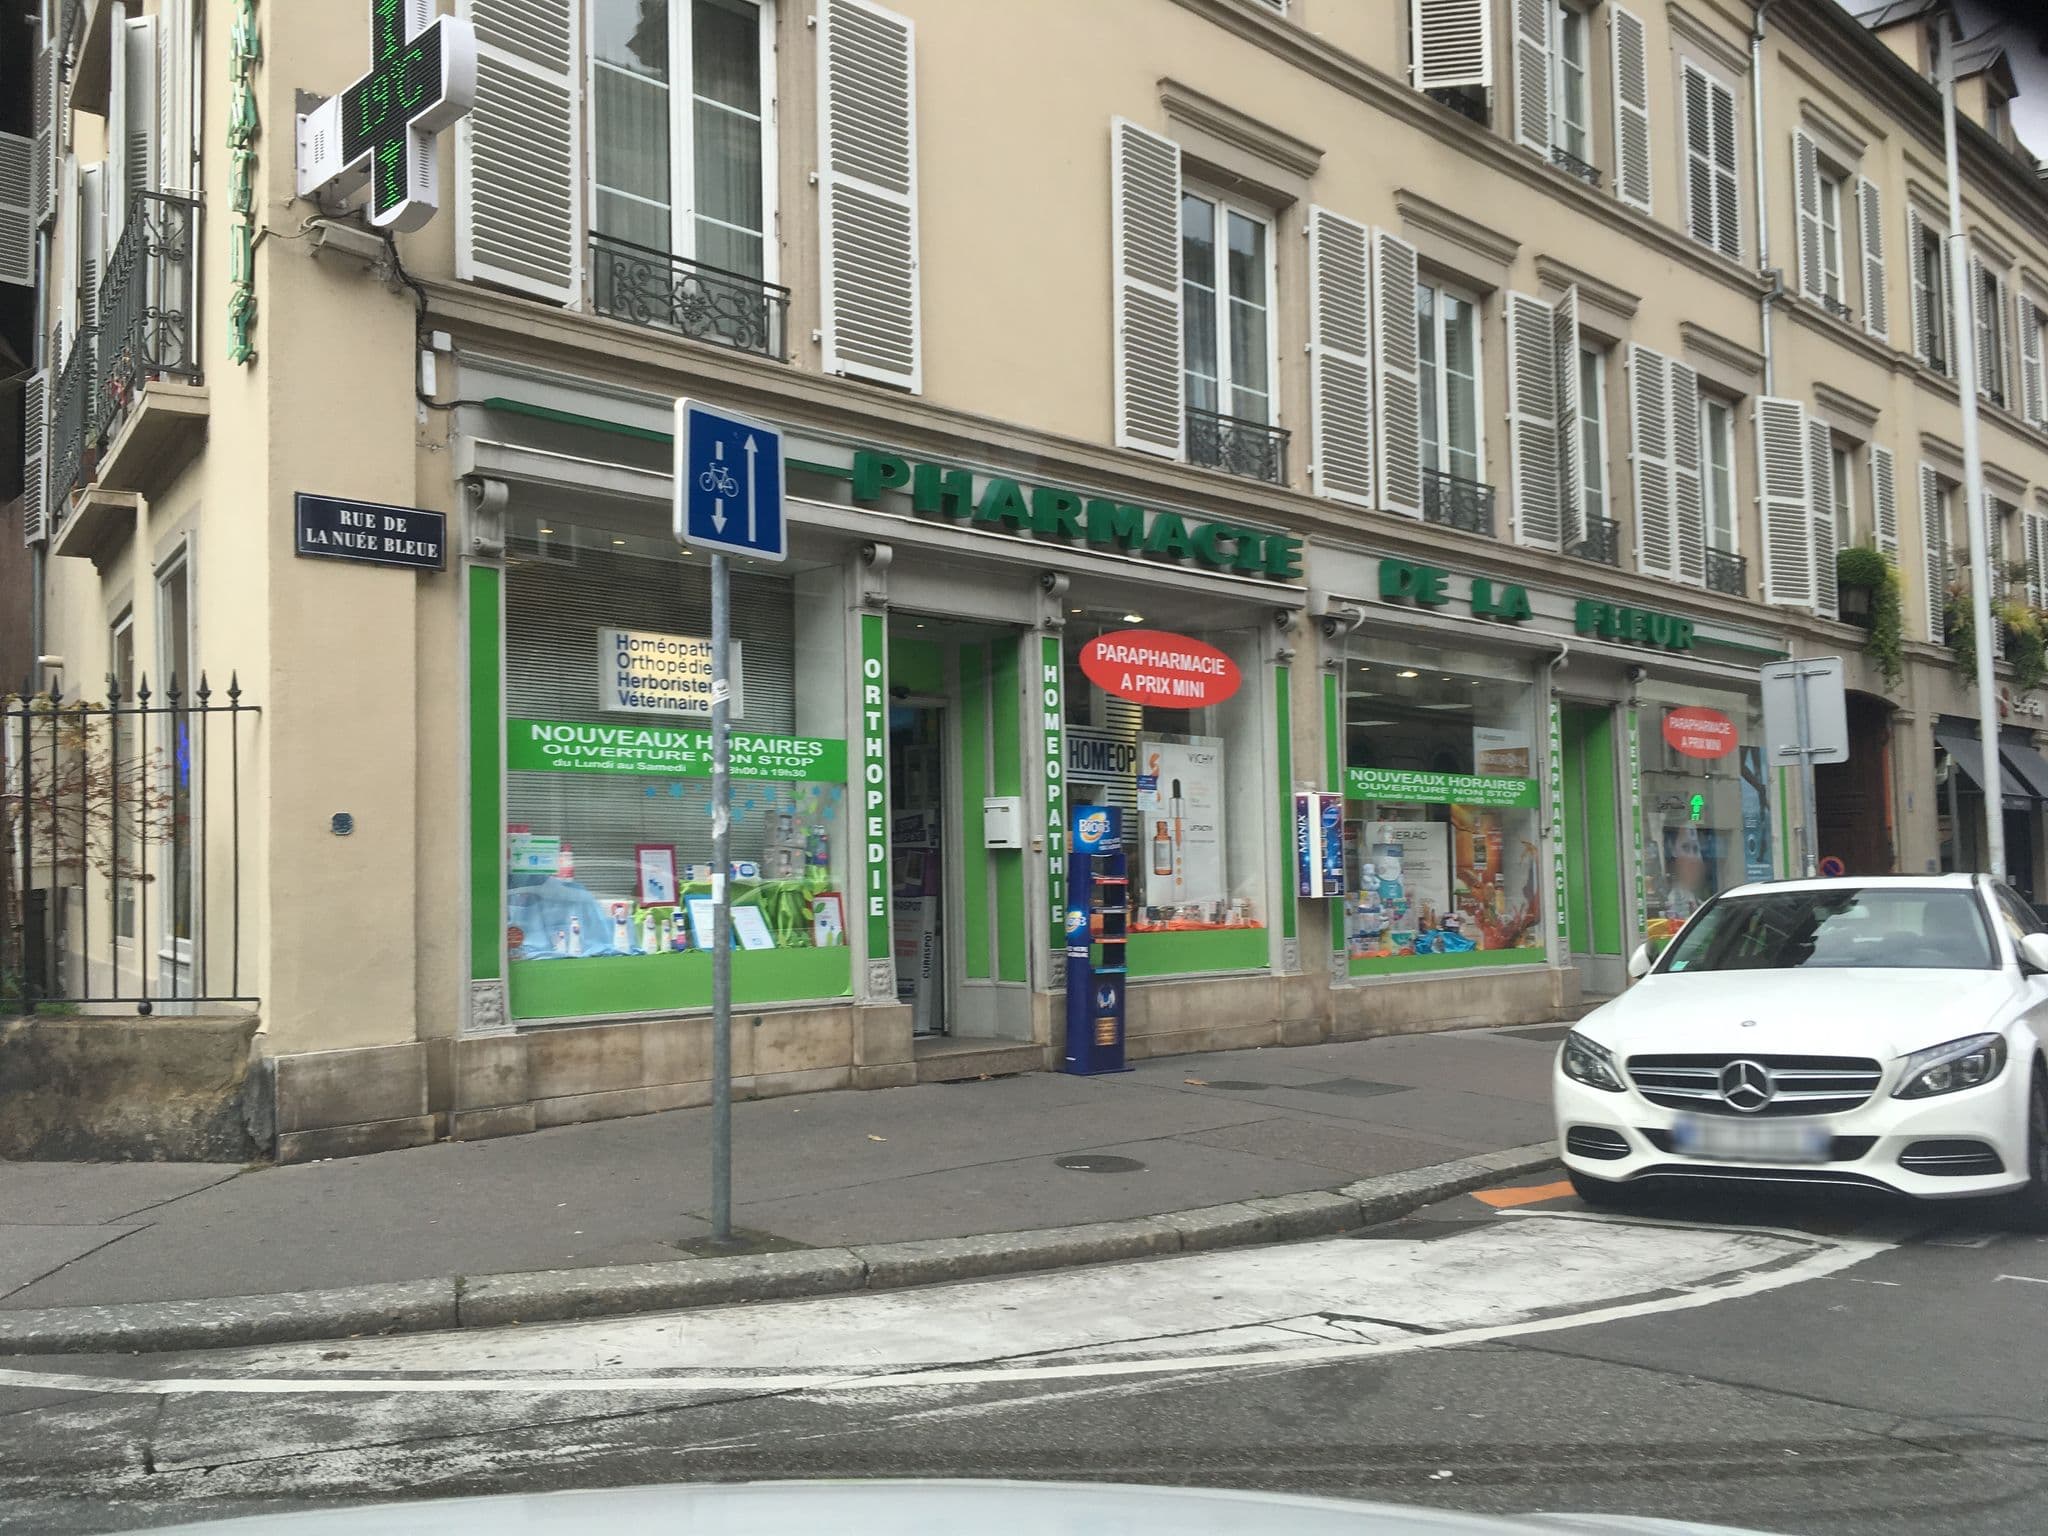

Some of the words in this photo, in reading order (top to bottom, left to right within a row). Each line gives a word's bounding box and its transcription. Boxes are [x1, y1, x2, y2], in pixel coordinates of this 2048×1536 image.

[340, 510, 376, 529] RUE
[384, 516, 407, 533] DE
[306, 528, 329, 544] LA
[332, 532, 378, 550] NUÉE
[384, 537, 438, 558] BLEUE
[852, 449, 1303, 580] PHARMACIE
[1378, 558, 1450, 606] DE
[1471, 576, 1533, 621] LA
[1575, 600, 1695, 650] FLEUR
[616, 634, 713, 658] Homéopath
[617, 652, 713, 676] Orthopédie
[1096, 643, 1226, 676] PARAPHARMACIE
[617, 671, 713, 694] Herborister
[1120, 673, 1133, 691] A
[1135, 675, 1171, 695] PRIX
[1173, 679, 1205, 699] MINI
[618, 690, 709, 712] Vétérinaire
[532, 724, 689, 749] NOUVEAUX
[543, 744, 697, 762] OUVERTURE
[758, 755, 815, 767] STOP
[553, 759, 571, 767] du
[575, 759, 614, 769] Lundi
[636, 762, 686, 772] Samedi
[772, 768, 807, 778] 19h30
[1350, 769, 1445, 786] NOUVEAUX
[1448, 776, 1526, 791] HORAIRES
[864, 658, 885, 916] ORTHOPEDIE
[1044, 665, 1064, 923] HOMEOPATHIE
[1357, 782, 1449, 794] OUVERTURE
[1453, 787, 1484, 796] NON
[1487, 790, 1521, 798] STOP
[1298, 814, 1310, 853] MANIX
